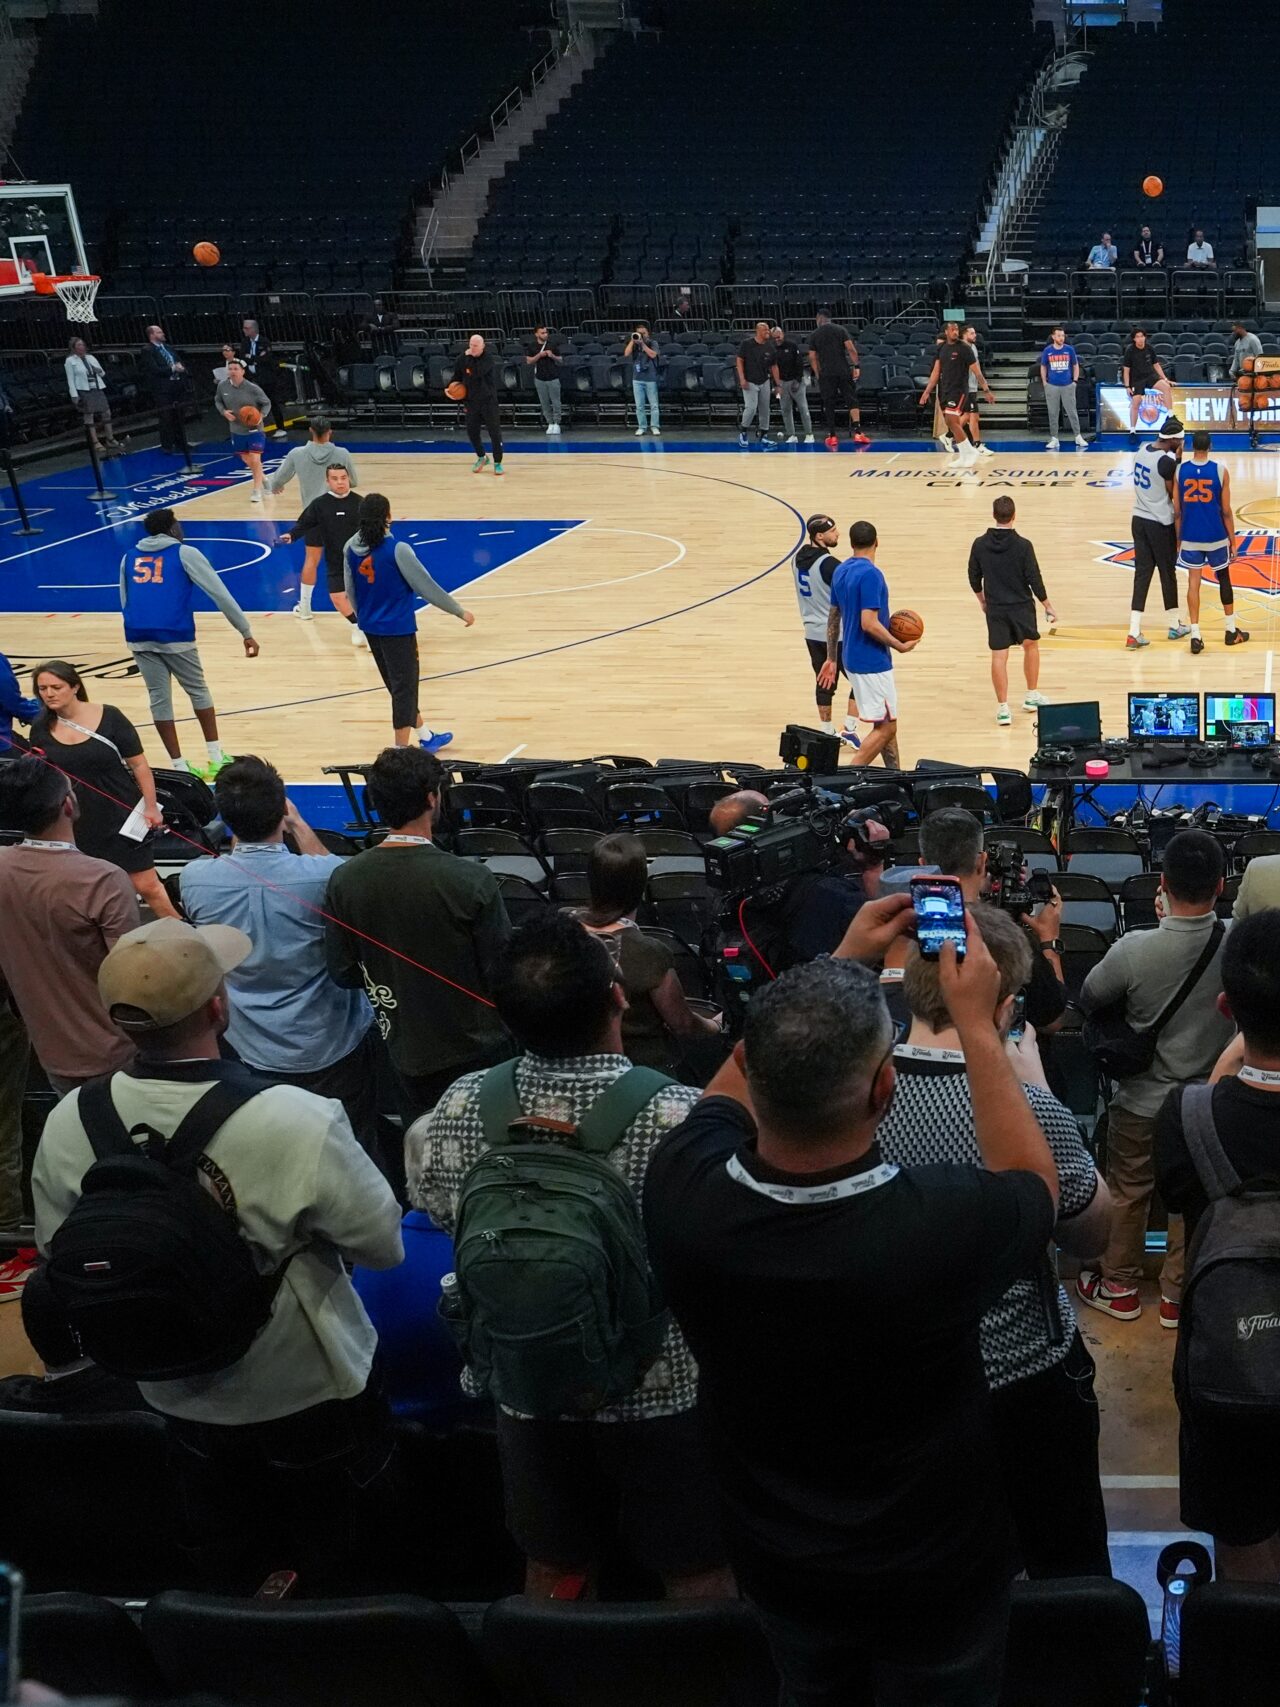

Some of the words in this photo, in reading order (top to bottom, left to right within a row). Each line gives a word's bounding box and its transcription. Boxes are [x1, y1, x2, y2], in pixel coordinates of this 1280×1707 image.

[1185, 397, 1230, 422] NEW
[926, 480, 1076, 488] CHASE
[988, 468, 1097, 478] SQUARE
[1133, 462, 1151, 490] 55
[96, 485, 208, 518] Michelob
[1183, 478, 1214, 504] 25
[133, 556, 164, 584] 51
[357, 554, 376, 584] 4
